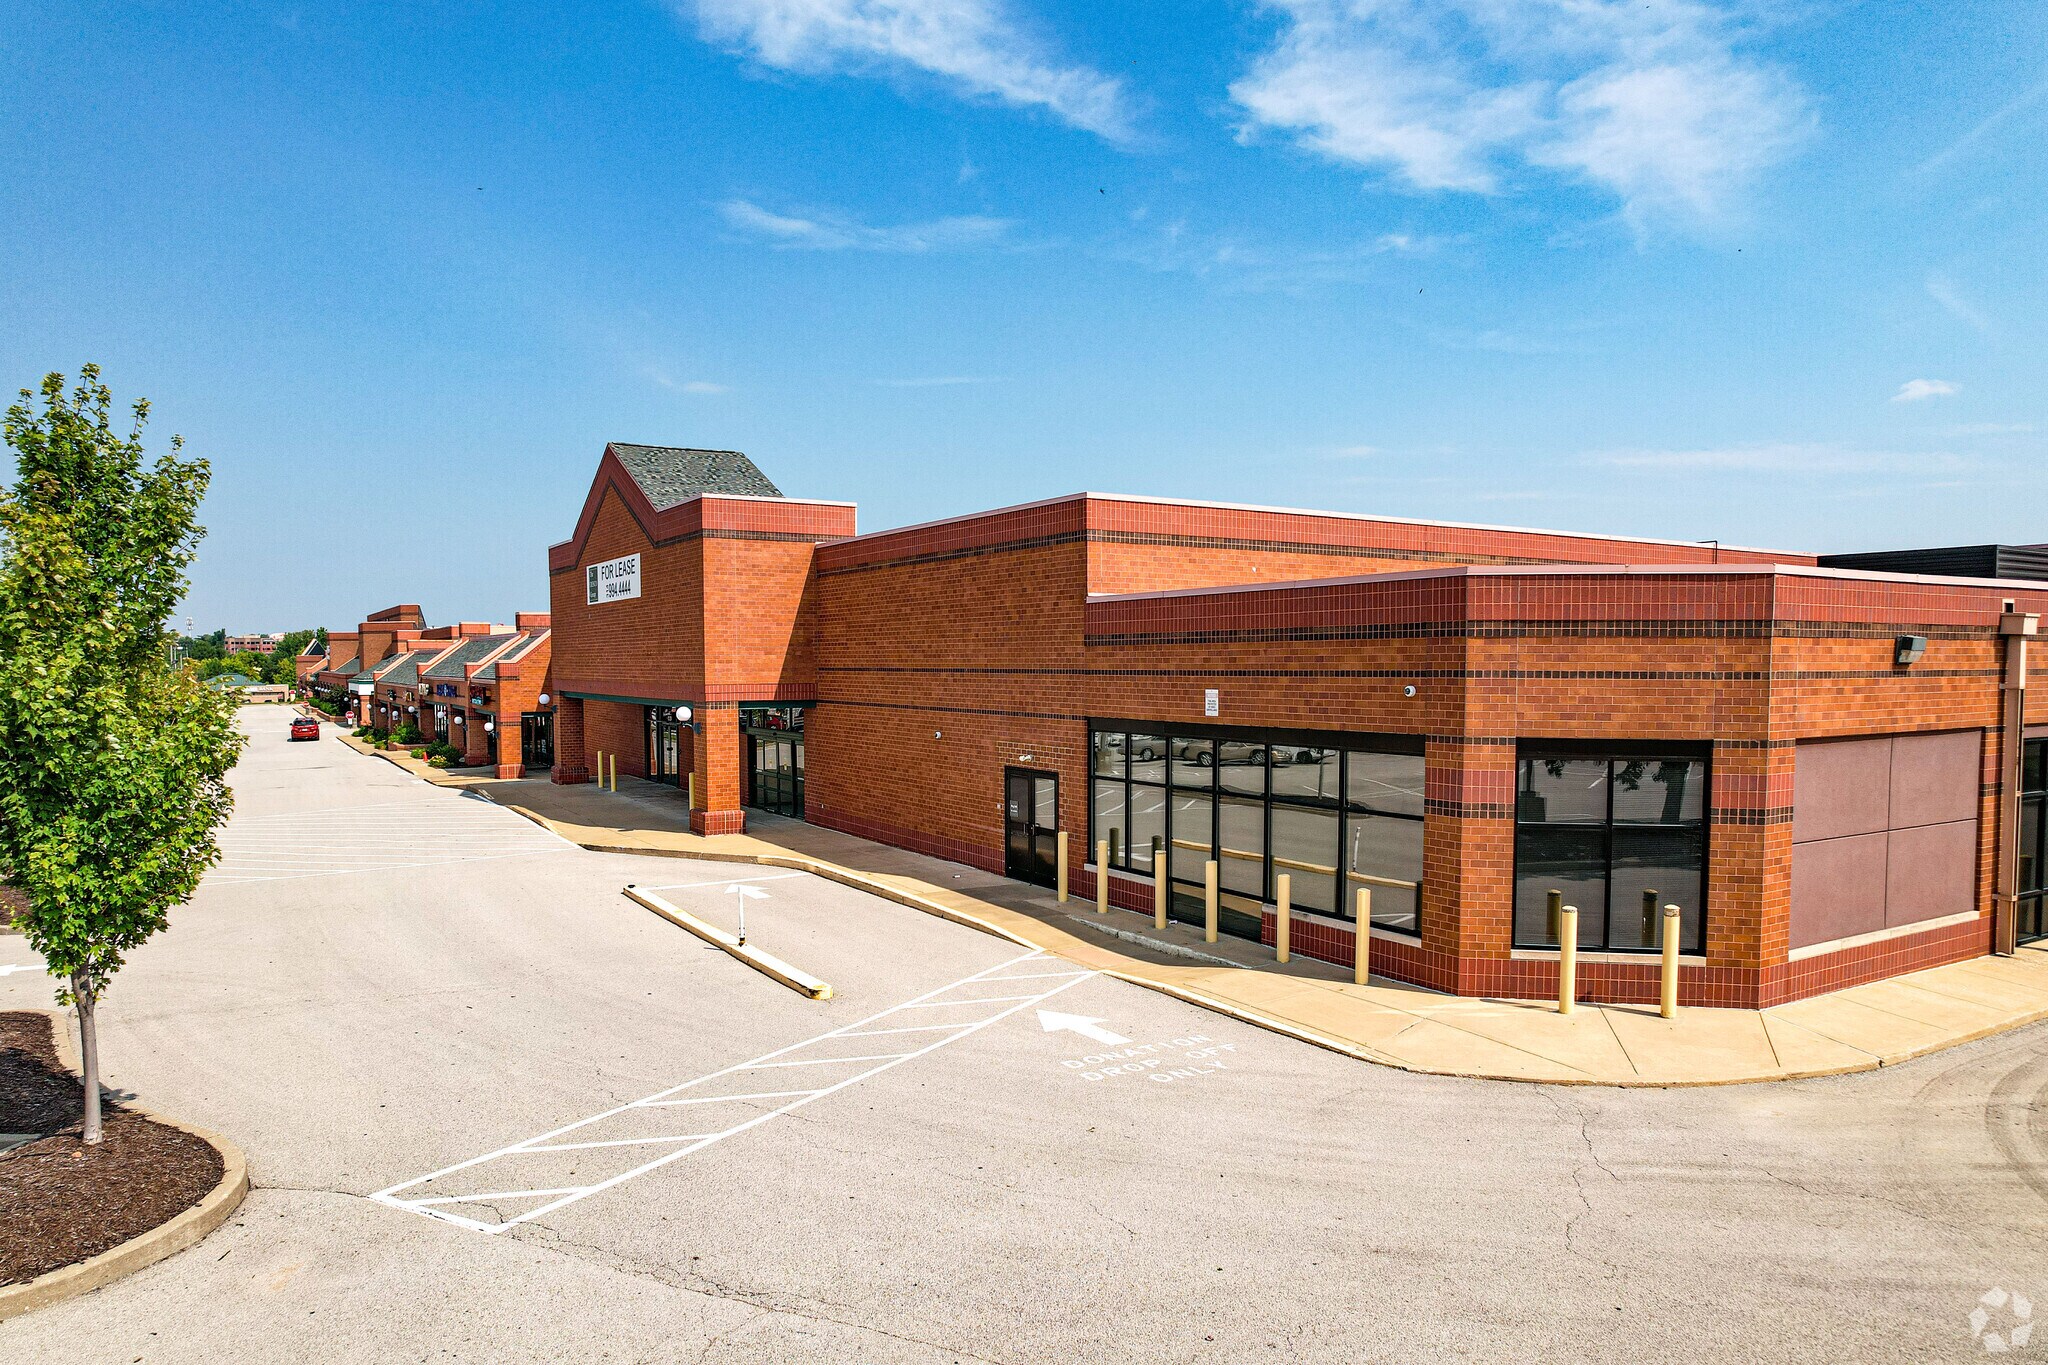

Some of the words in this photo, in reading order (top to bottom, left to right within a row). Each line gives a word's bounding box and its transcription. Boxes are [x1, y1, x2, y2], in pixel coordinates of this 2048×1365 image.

[602, 564, 614, 580] FOR
[615, 559, 635, 577] LEASE
[1060, 1034, 1215, 1069] DONATION
[1079, 1059, 1161, 1081] DROP
[1185, 1043, 1237, 1059] OFF
[1149, 1060, 1228, 1083] ONLY
